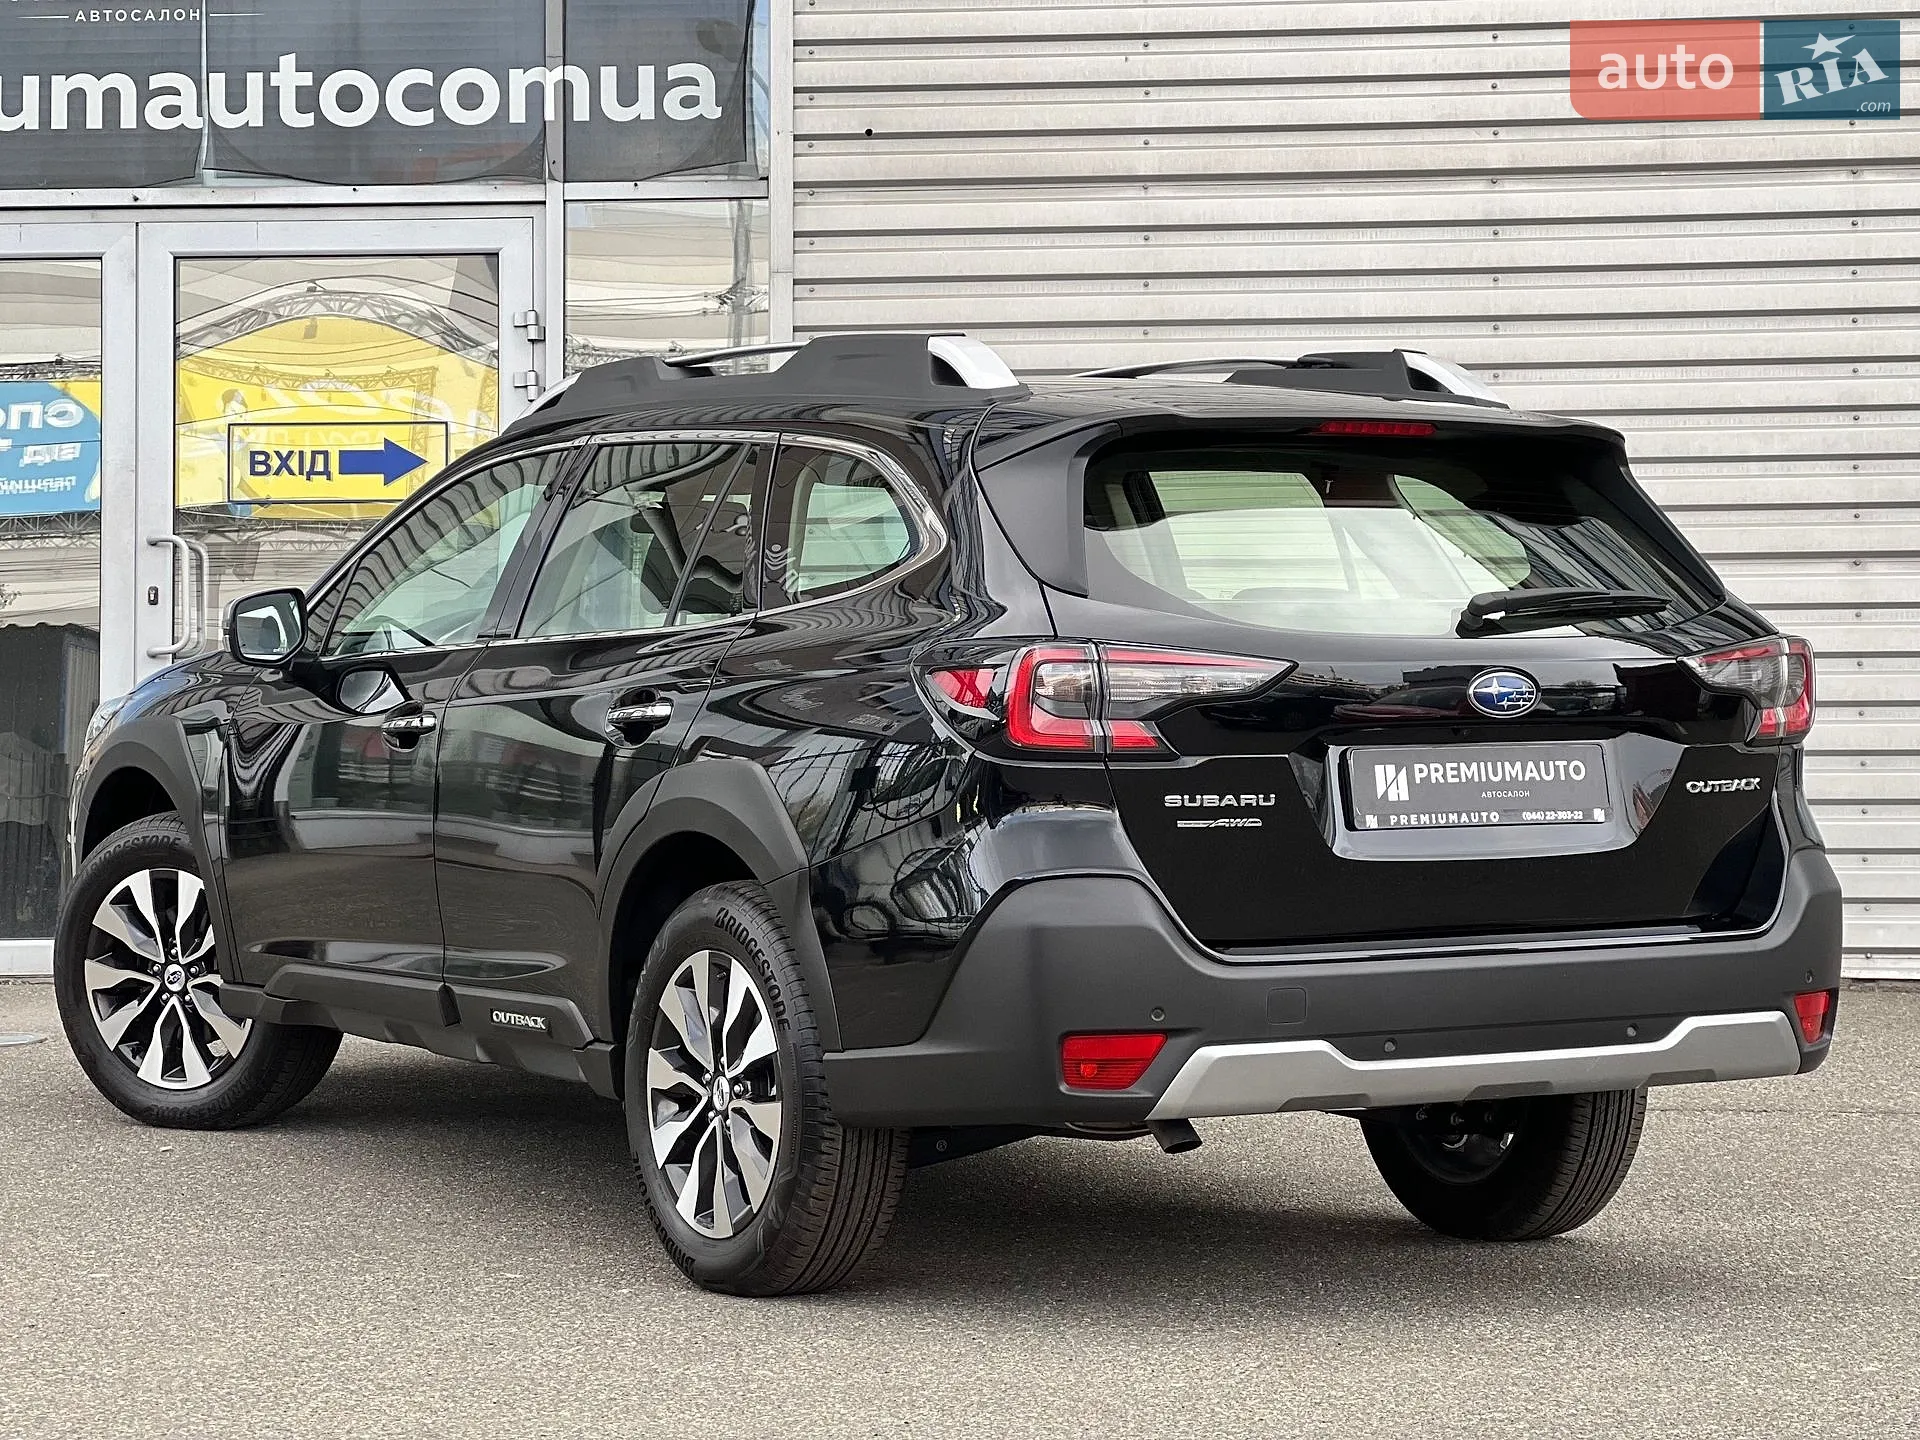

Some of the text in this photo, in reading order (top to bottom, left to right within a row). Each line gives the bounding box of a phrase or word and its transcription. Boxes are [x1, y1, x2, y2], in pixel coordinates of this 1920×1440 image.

[74, 8, 201, 23] АВТОСАЛОН
[249, 449, 333, 482] ВХІД
[1413, 759, 1587, 785] PREMIUMAUTO
[1685, 777, 1761, 794] OUTBACK
[1164, 793, 1276, 807] SUBARU
[1481, 790, 1531, 799] АВТОСАЛОН
[1209, 817, 1263, 828] AWD
[1389, 811, 1500, 827] PREMIUMAUTO
[713, 906, 791, 1032] BRIDGESTONE
[492, 1010, 547, 1030] OUTBACK
